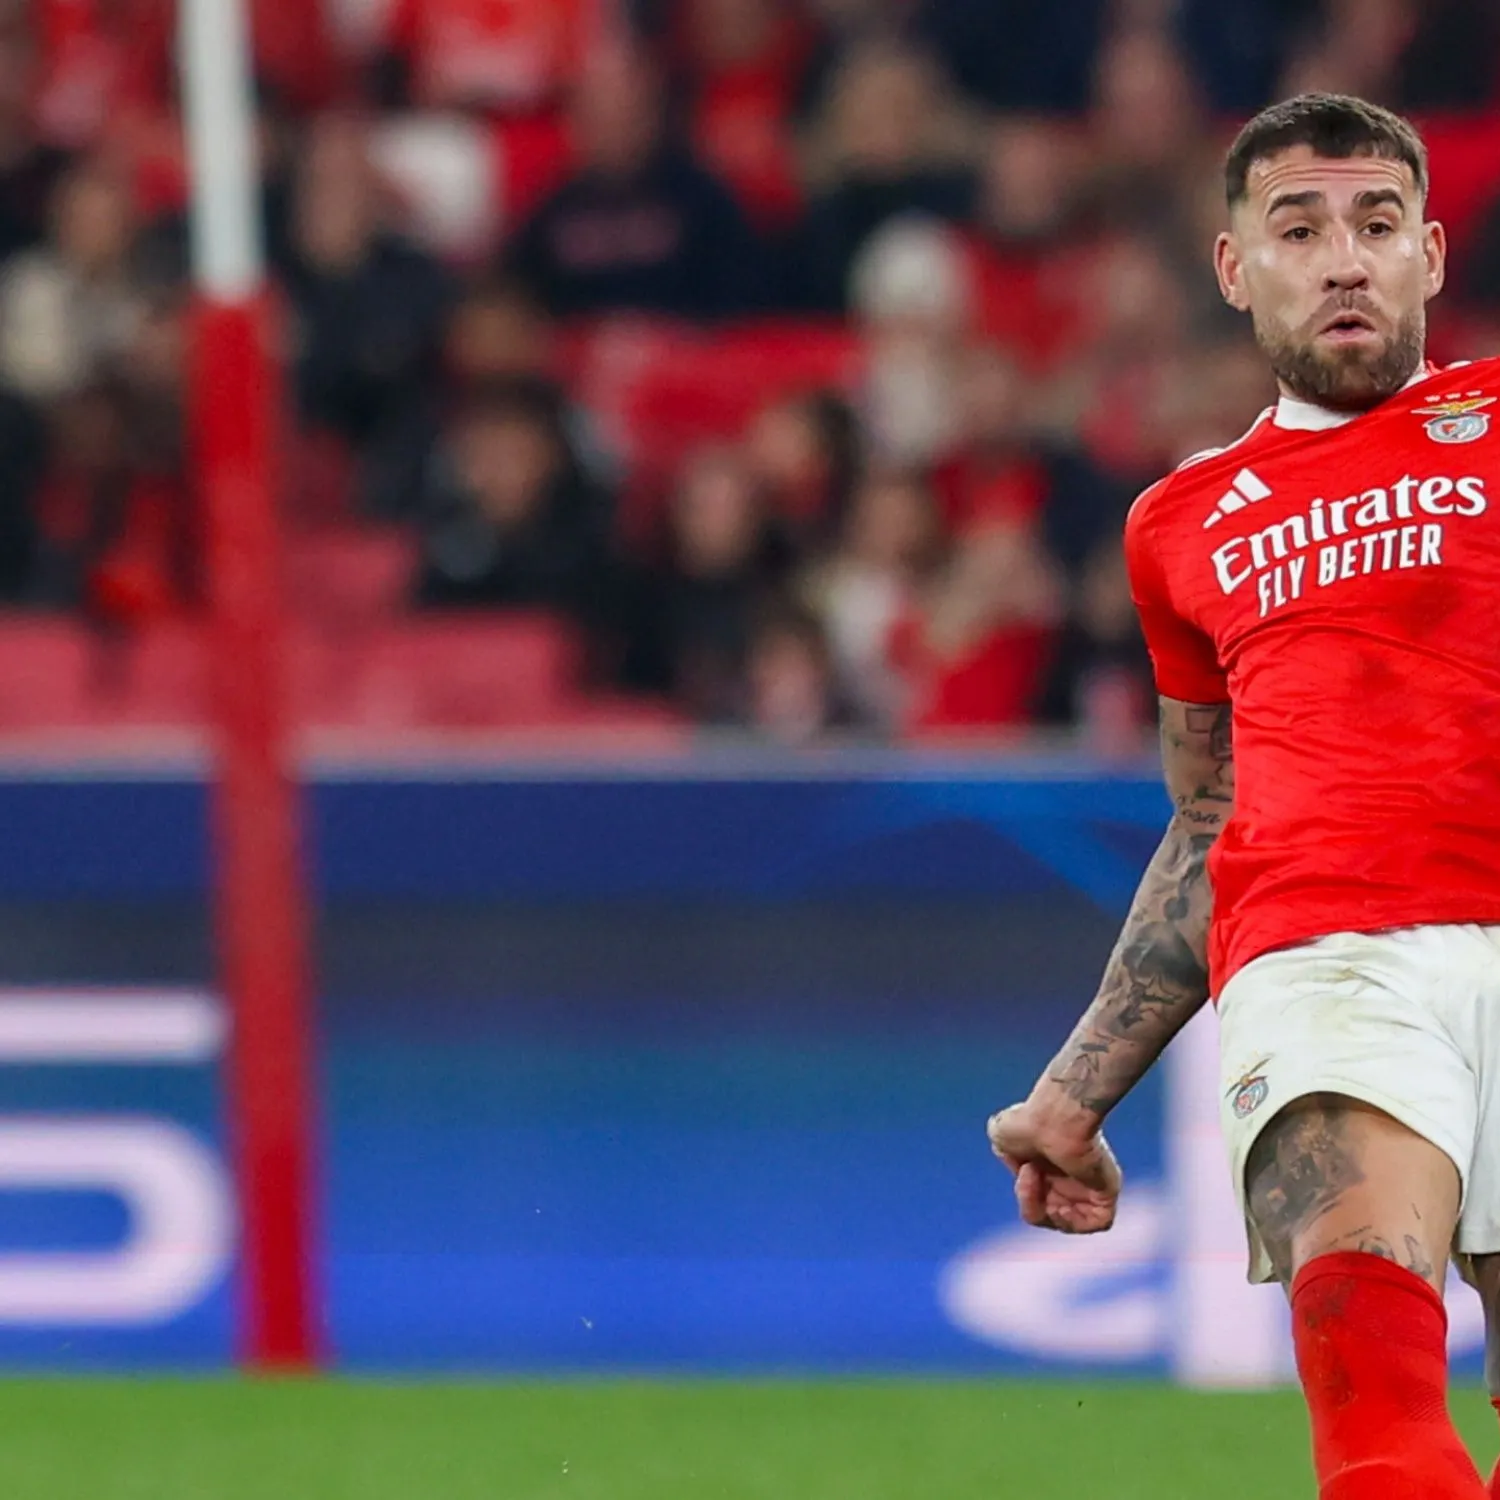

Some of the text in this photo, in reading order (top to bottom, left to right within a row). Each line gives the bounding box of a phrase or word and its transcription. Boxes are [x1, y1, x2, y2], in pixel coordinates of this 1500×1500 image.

[1210, 474, 1487, 595] Emirates
[1258, 523, 1442, 618] FLY BETTER
